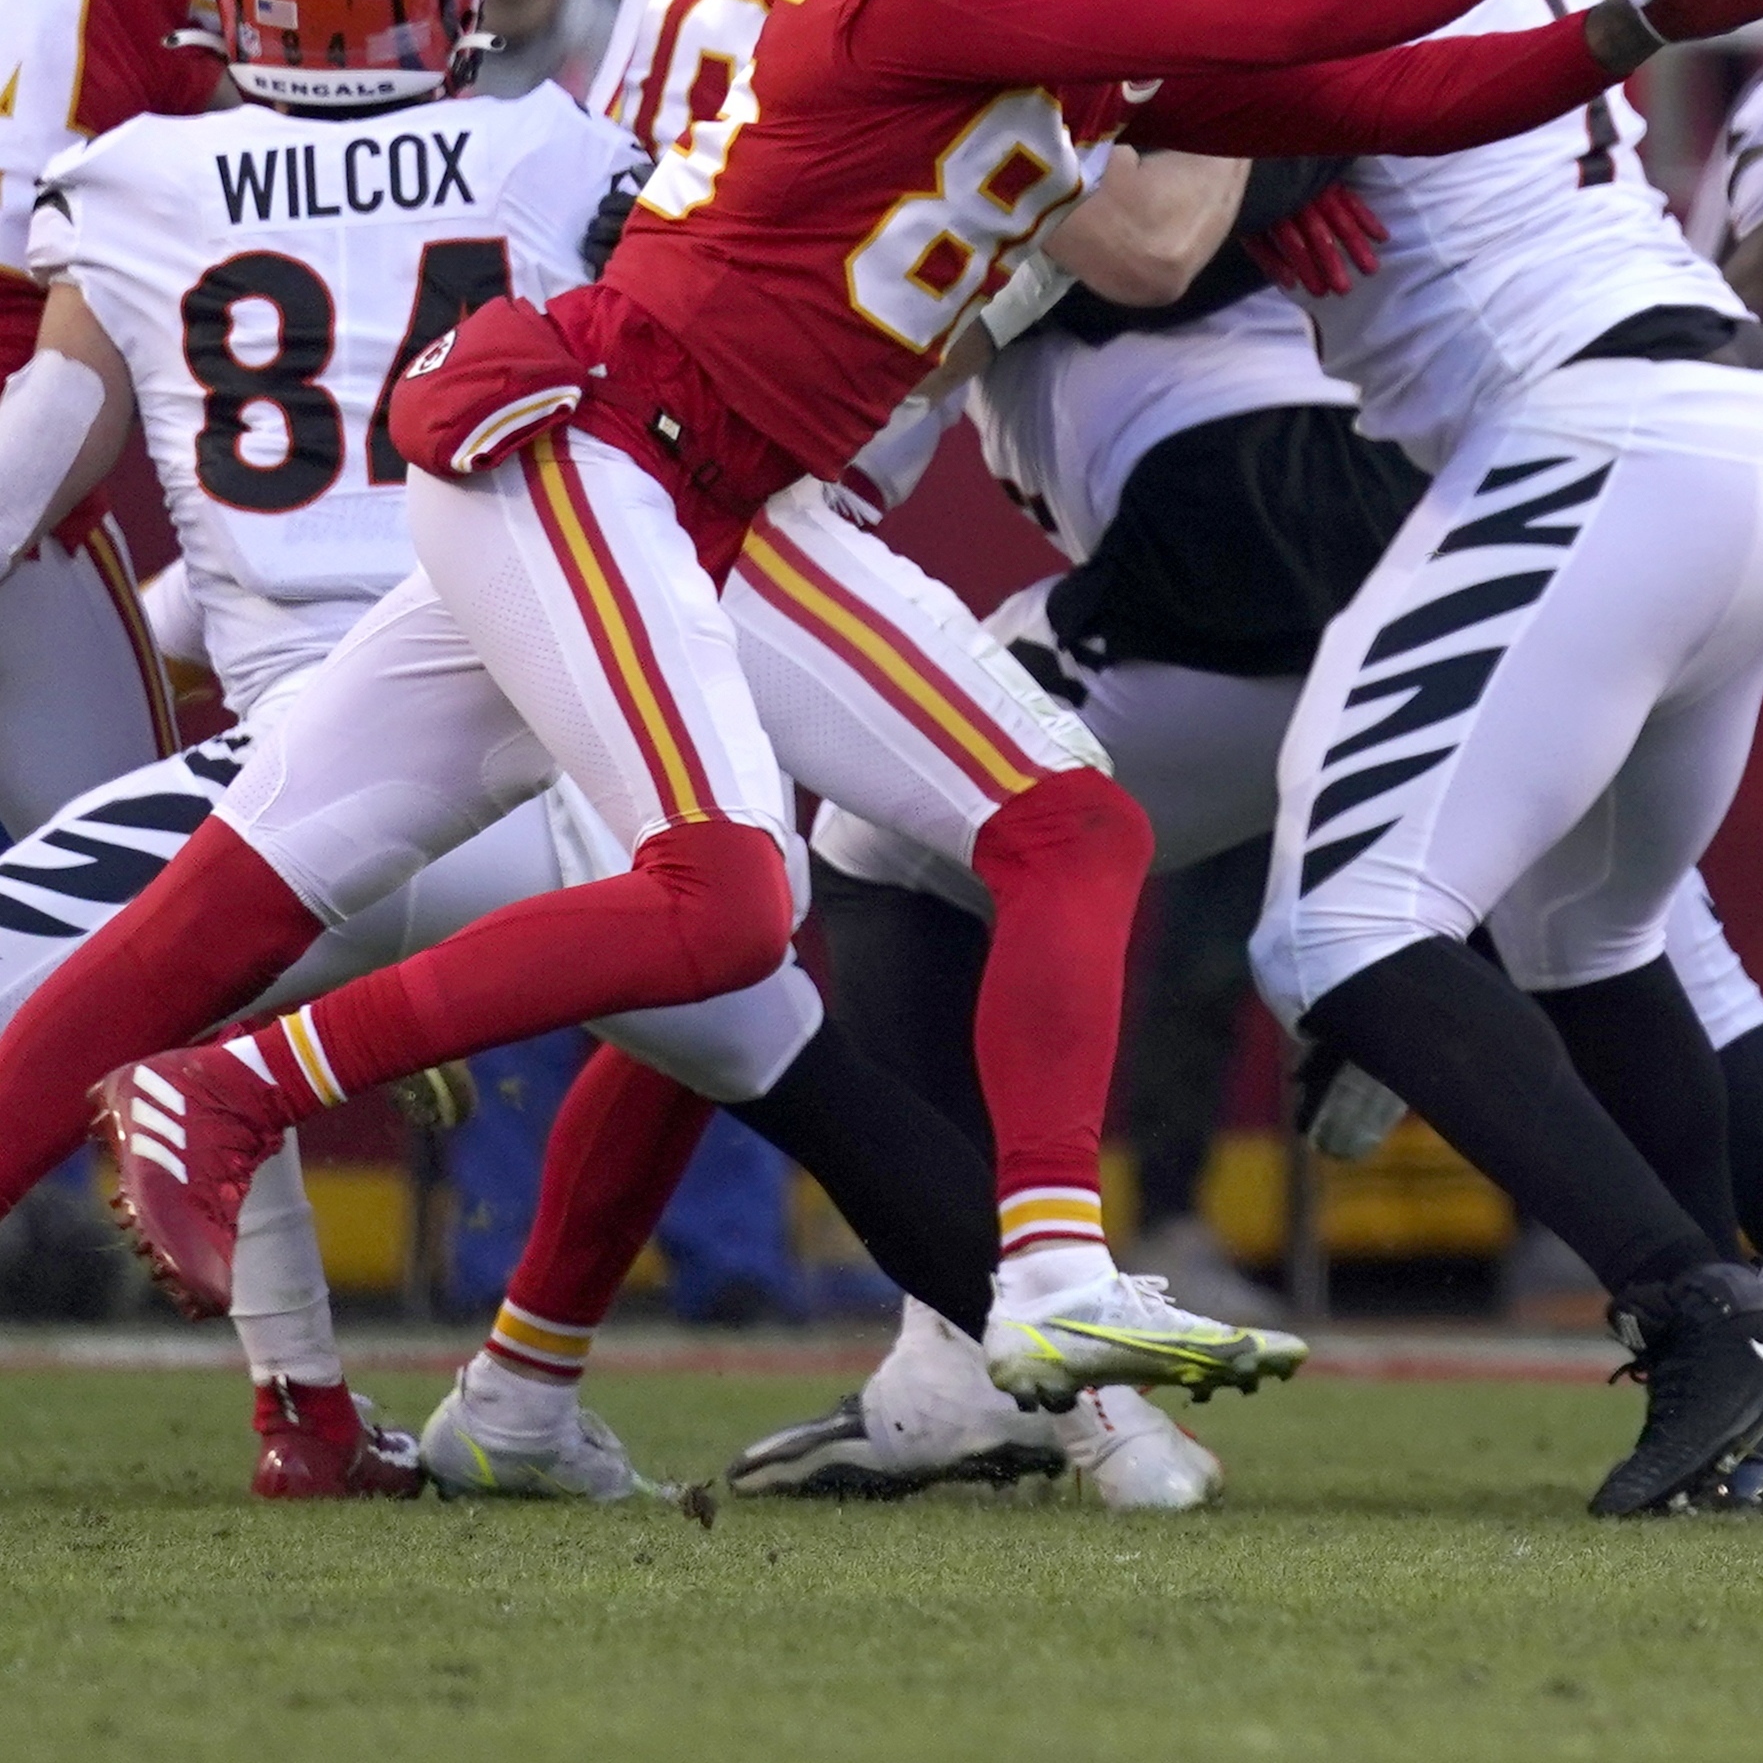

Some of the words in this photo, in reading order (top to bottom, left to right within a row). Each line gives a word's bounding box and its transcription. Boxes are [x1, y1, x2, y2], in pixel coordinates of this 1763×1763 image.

[253, 74, 398, 100] BENGALS
[215, 130, 476, 226] WILCOX
[180, 235, 514, 514] 84
